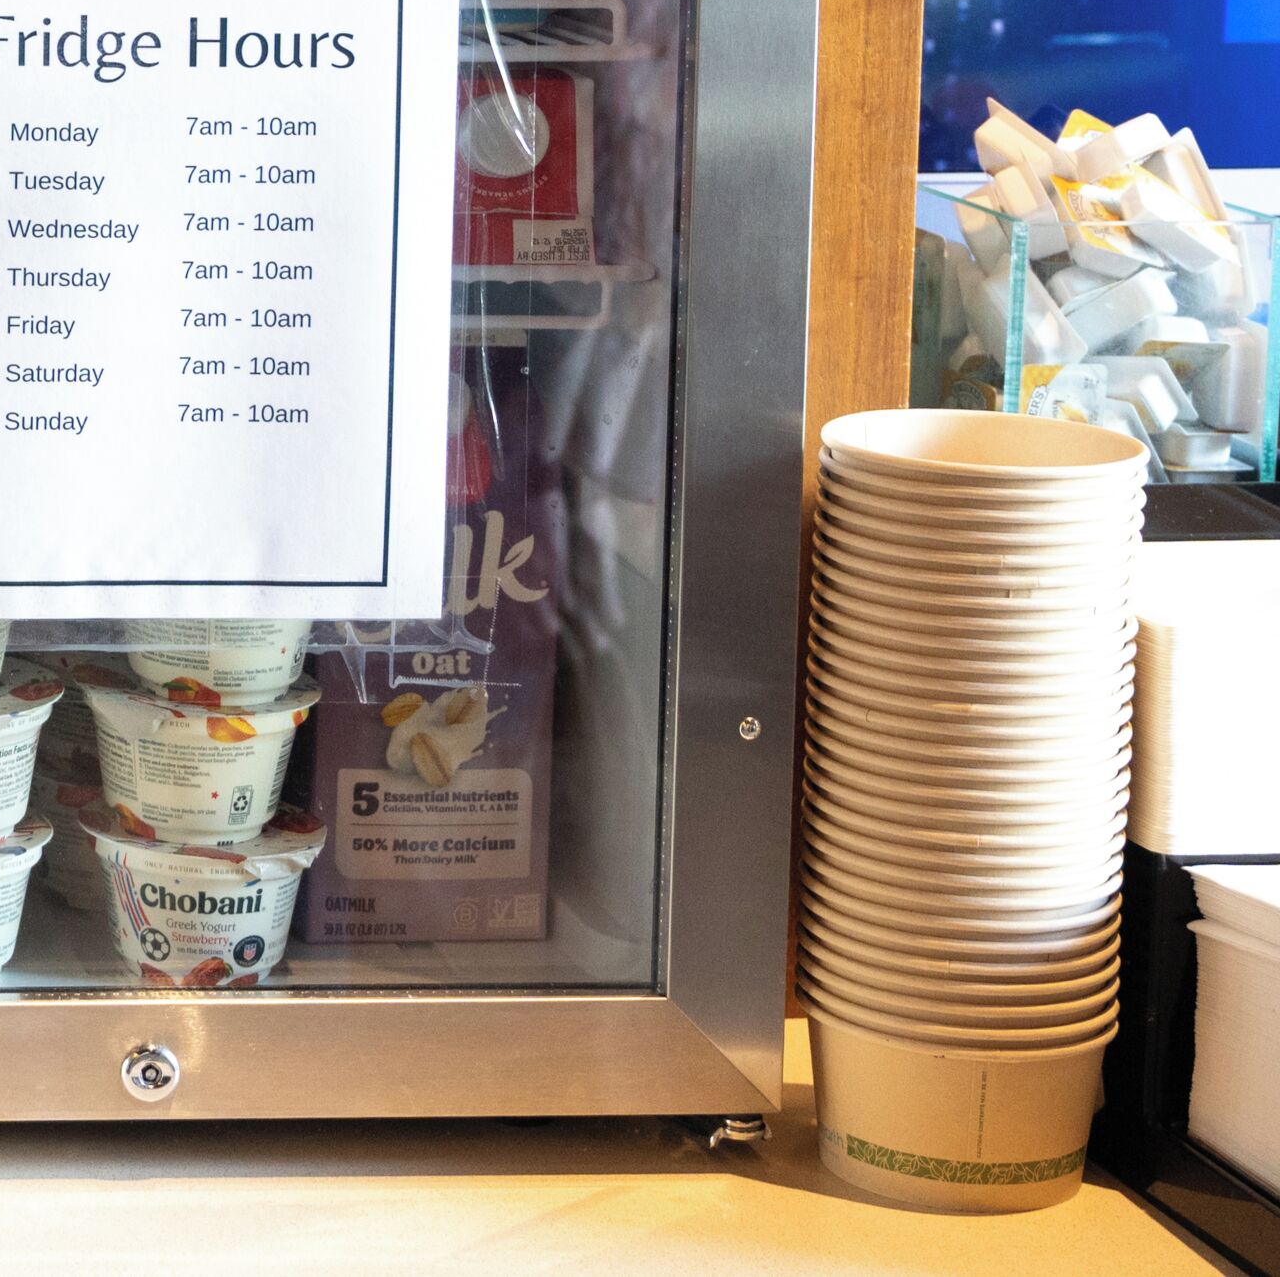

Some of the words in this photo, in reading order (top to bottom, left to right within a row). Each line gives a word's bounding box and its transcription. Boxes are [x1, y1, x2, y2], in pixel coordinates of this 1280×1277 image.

[189, 16, 356, 69] Hours
[10, 123, 99, 146] Monday
[186, 117, 233, 136] 7am
[256, 117, 317, 136] 10am
[9, 171, 105, 195] Tuesday
[185, 165, 231, 184] 7am
[254, 165, 316, 184] 10am
[8, 219, 139, 243] Wednesday
[183, 213, 230, 231] 7am
[253, 213, 314, 232] 10am
[7, 268, 111, 291] Thursday
[182, 261, 228, 279] 7am
[251, 261, 313, 280] 10am
[7, 316, 76, 339] Friday
[180, 309, 227, 328] 7am
[250, 309, 312, 328] 10am
[5, 364, 104, 387] Saturday
[179, 356, 226, 375] 7am
[249, 356, 310, 376] 10am
[4, 412, 88, 435] Sunday
[178, 404, 224, 422] 7am
[247, 404, 309, 423] 10am
[352, 782, 380, 817] 5
[383, 790, 449, 803] Essential
[452, 790, 519, 803] Nutrients
[352, 837, 388, 851] 50%
[392, 838, 440, 851] More
[443, 836, 516, 851] Calcium
[140, 883, 263, 915] Chobani
[325, 897, 376, 913] OATMILK
[166, 918, 197, 931] Greek
[200, 921, 236, 934] Yogurt
[172, 932, 230, 947] Strawberry
